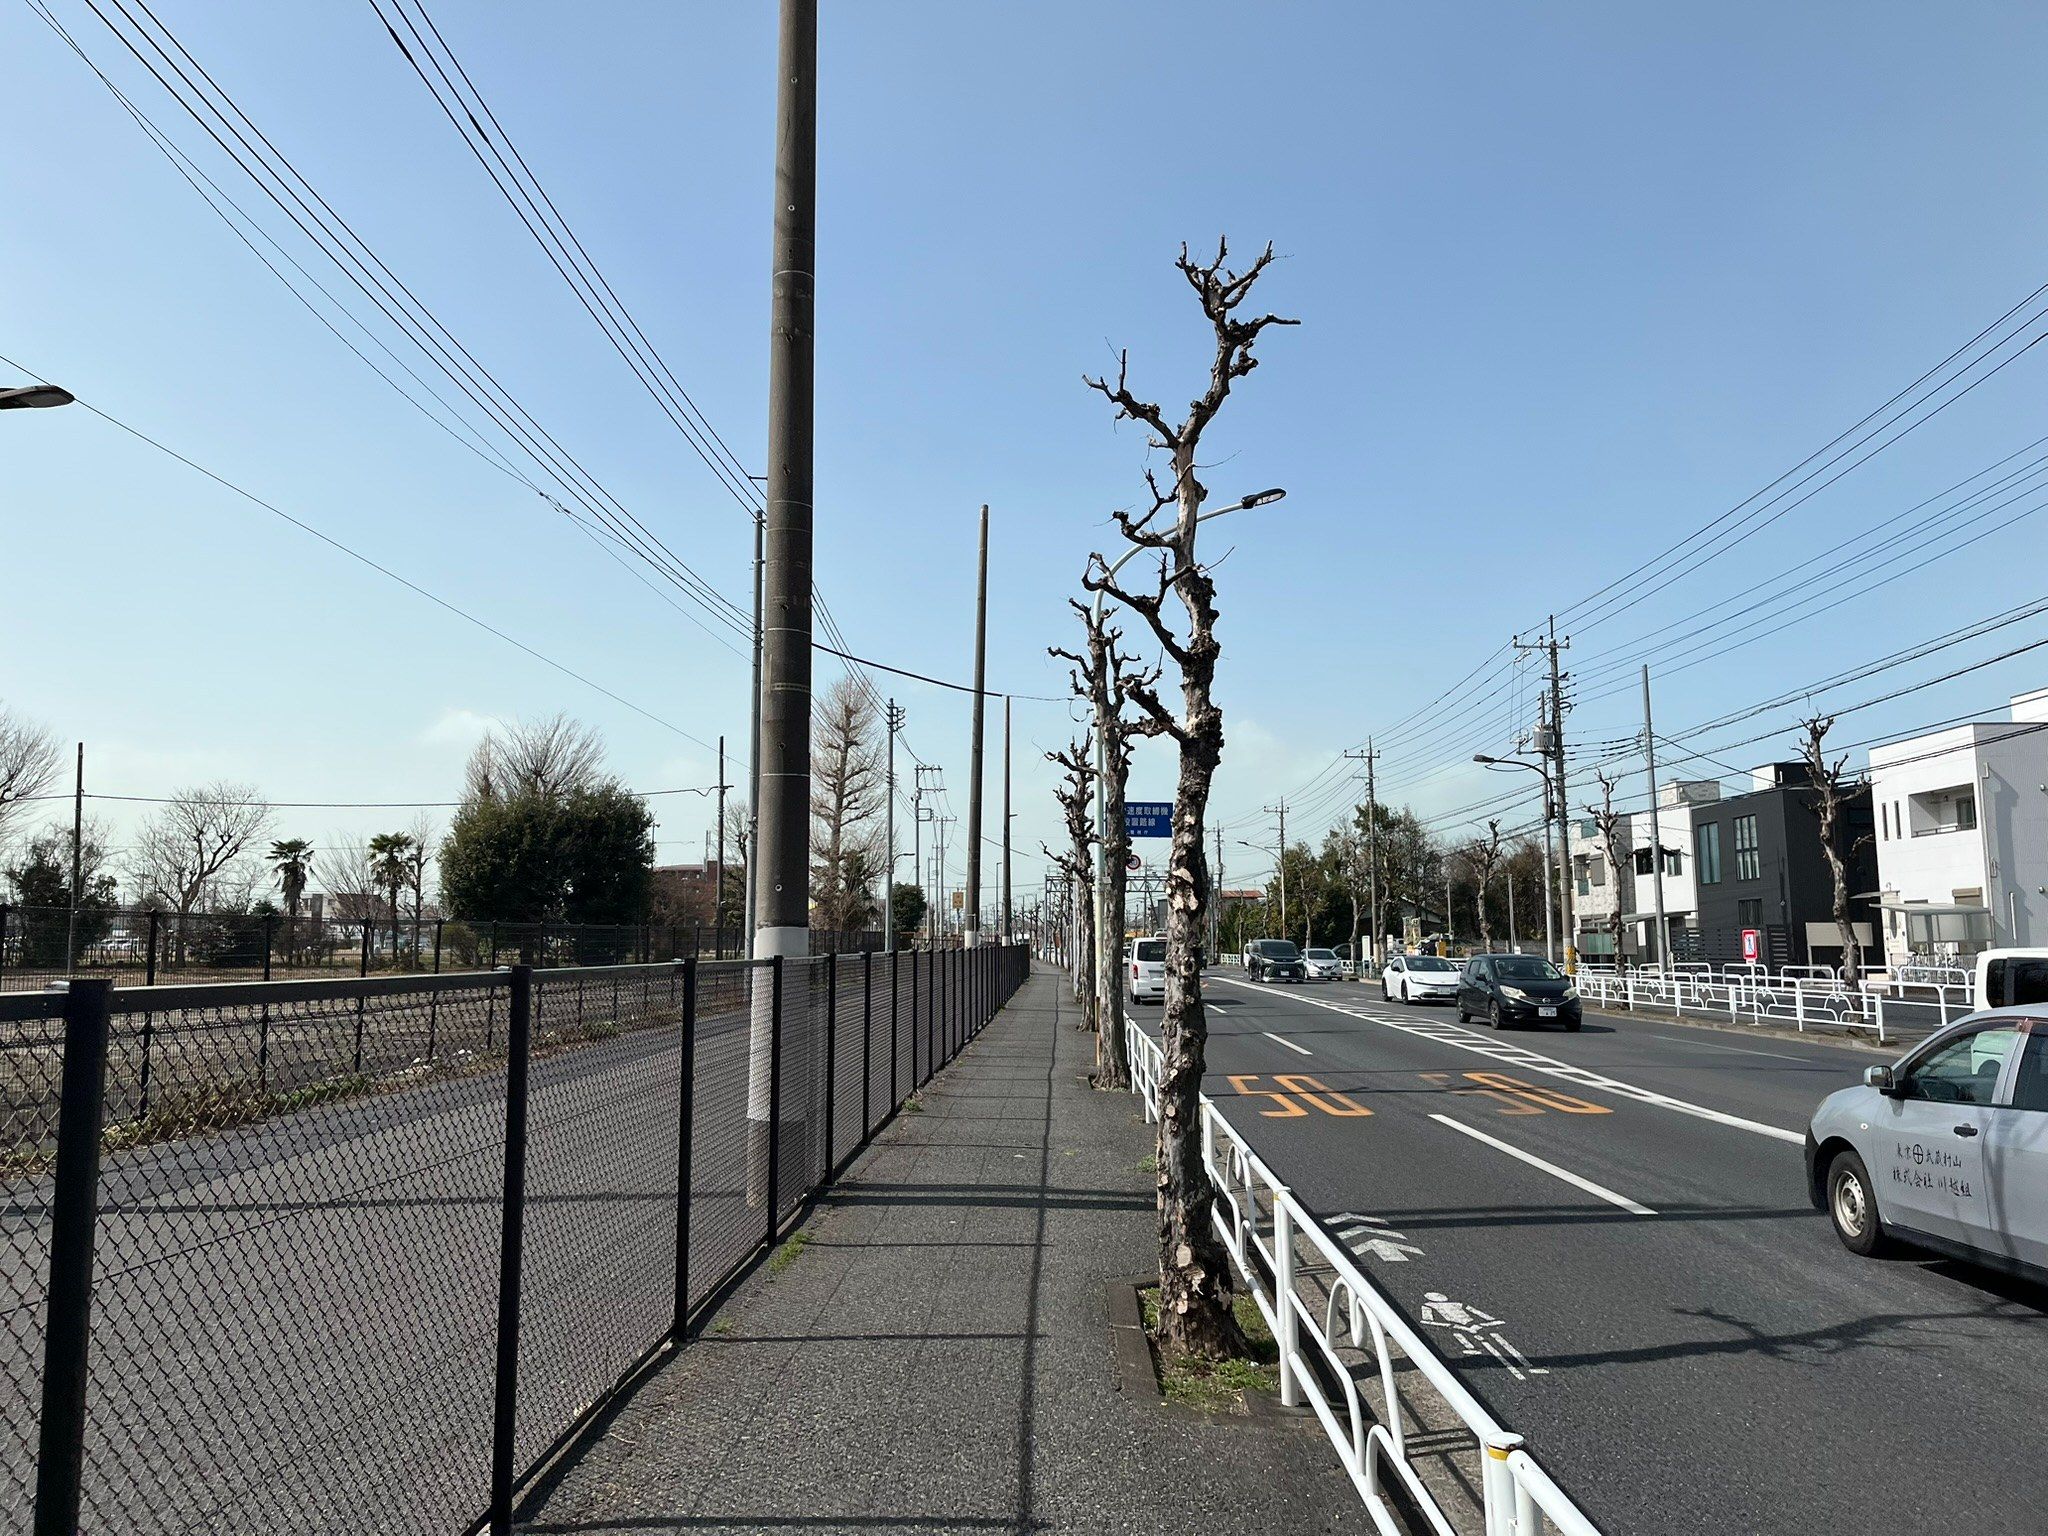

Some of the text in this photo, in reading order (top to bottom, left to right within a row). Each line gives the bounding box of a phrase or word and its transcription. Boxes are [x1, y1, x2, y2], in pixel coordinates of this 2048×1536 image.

[1124, 806, 1169, 816] 速度取締機
[1226, 1074, 1375, 1118] 50
[1418, 1072, 1614, 1116] 50
[1892, 1166, 1934, 1190] 株式会社
